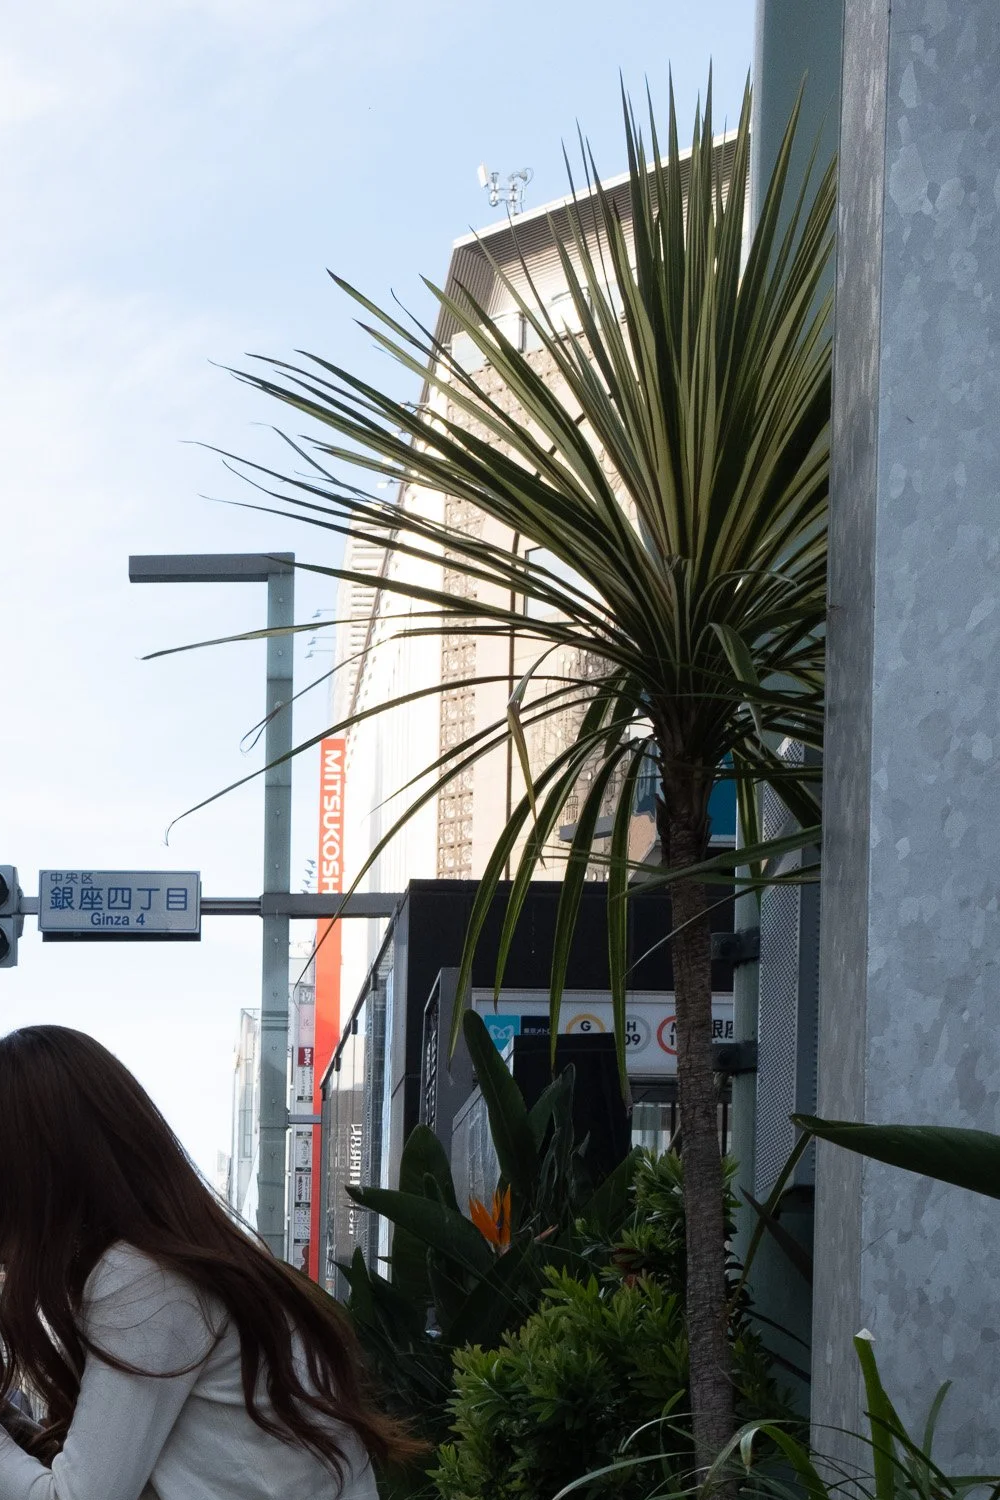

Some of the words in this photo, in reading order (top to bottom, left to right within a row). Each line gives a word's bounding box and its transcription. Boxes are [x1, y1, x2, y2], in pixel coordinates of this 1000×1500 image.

[321, 750, 342, 894] MITSUKOSH
[50, 872, 93, 884] 中央区
[49, 886, 188, 912] 銀座四丁目
[90, 912, 130, 926] Ginza
[135, 913, 146, 926] 4
